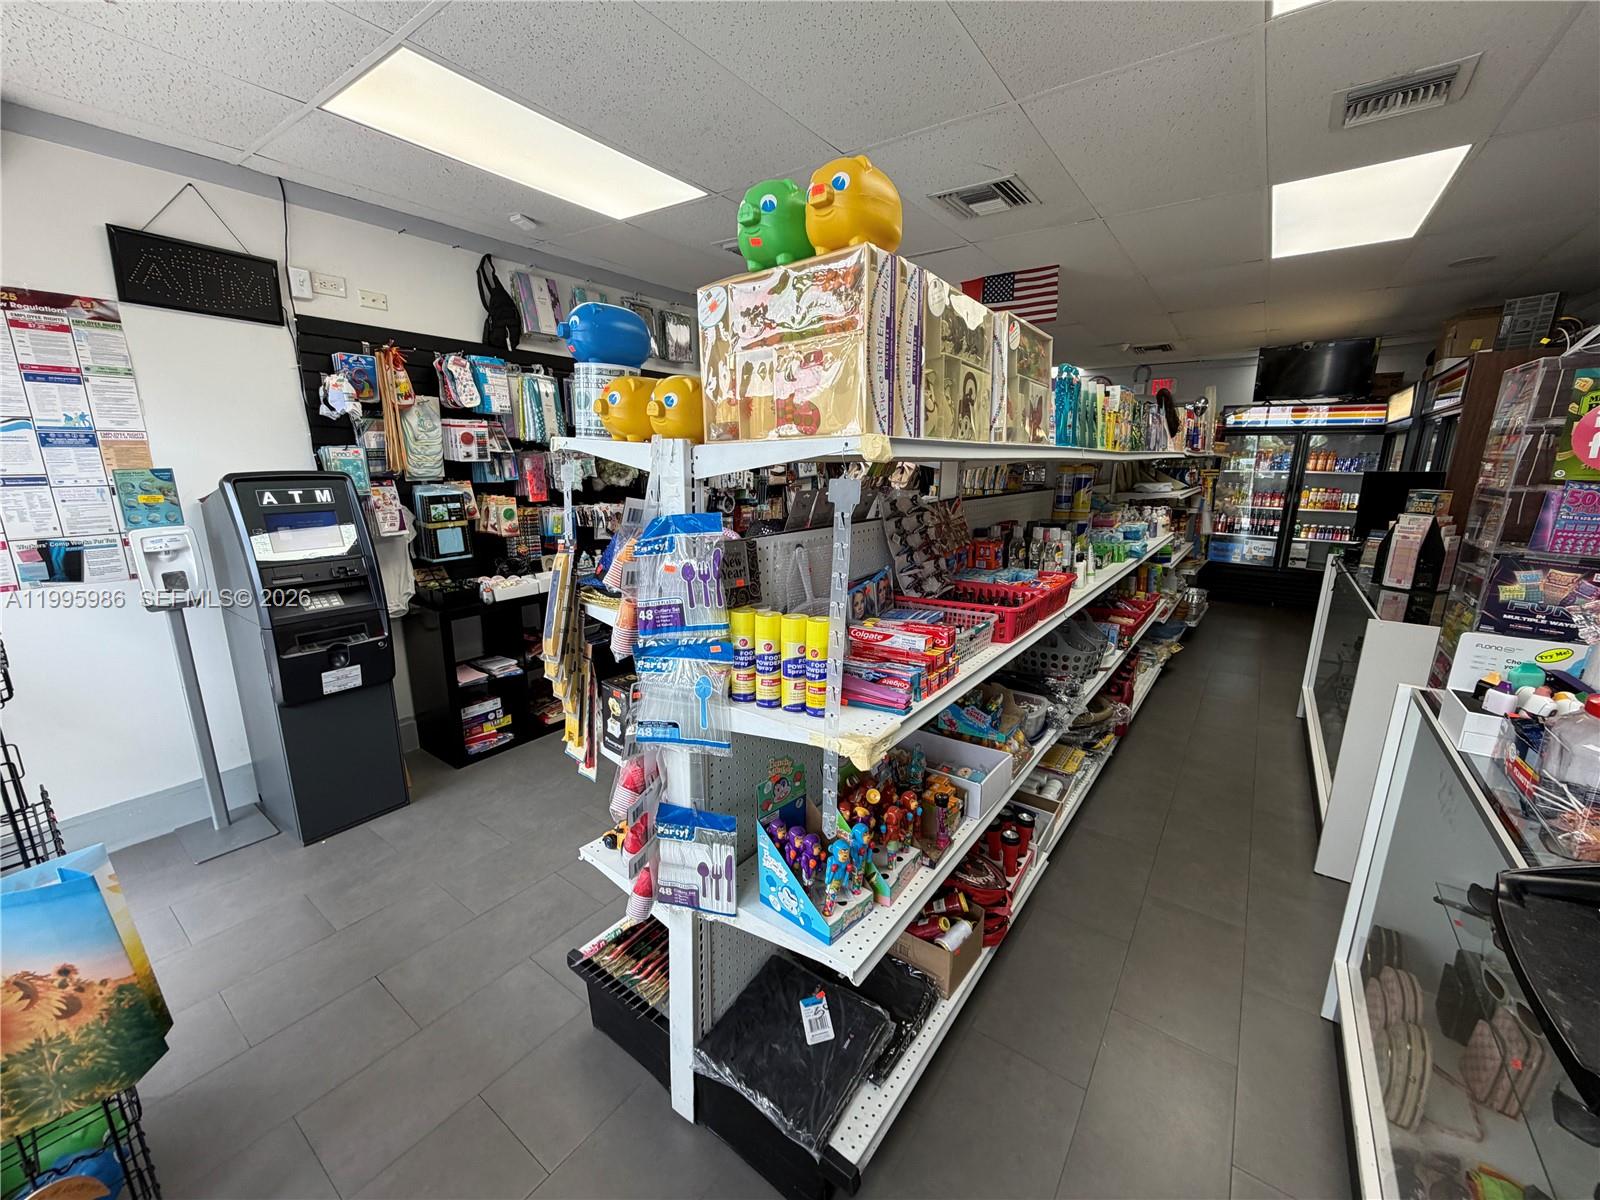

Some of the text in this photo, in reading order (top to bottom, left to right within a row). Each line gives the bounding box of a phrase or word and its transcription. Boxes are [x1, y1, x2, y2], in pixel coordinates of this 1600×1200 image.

[128, 252, 273, 307] ATM
[9, 301, 68, 315] Regulations
[876, 268, 891, 338] Ensemble
[10, 312, 42, 321] EMPLOYEE
[904, 279, 919, 345] Ensemble
[876, 339, 884, 373] Bath
[904, 348, 912, 378] Bath
[877, 375, 886, 412] Piece
[905, 380, 913, 415] Piece
[262, 488, 333, 505] ATM
[49, 541, 70, 549] Comp
[722, 556, 742, 568] New
[720, 566, 747, 580] Year!
[639, 609, 654, 621] 48
[1503, 614, 1548, 625] MULTIPLE
[850, 628, 884, 641] Colgate
[1538, 653, 1554, 661] Try
[881, 678, 911, 690] Colgate
[638, 727, 653, 737] 48
[657, 826, 689, 838] Party!
[658, 887, 673, 896] 48
